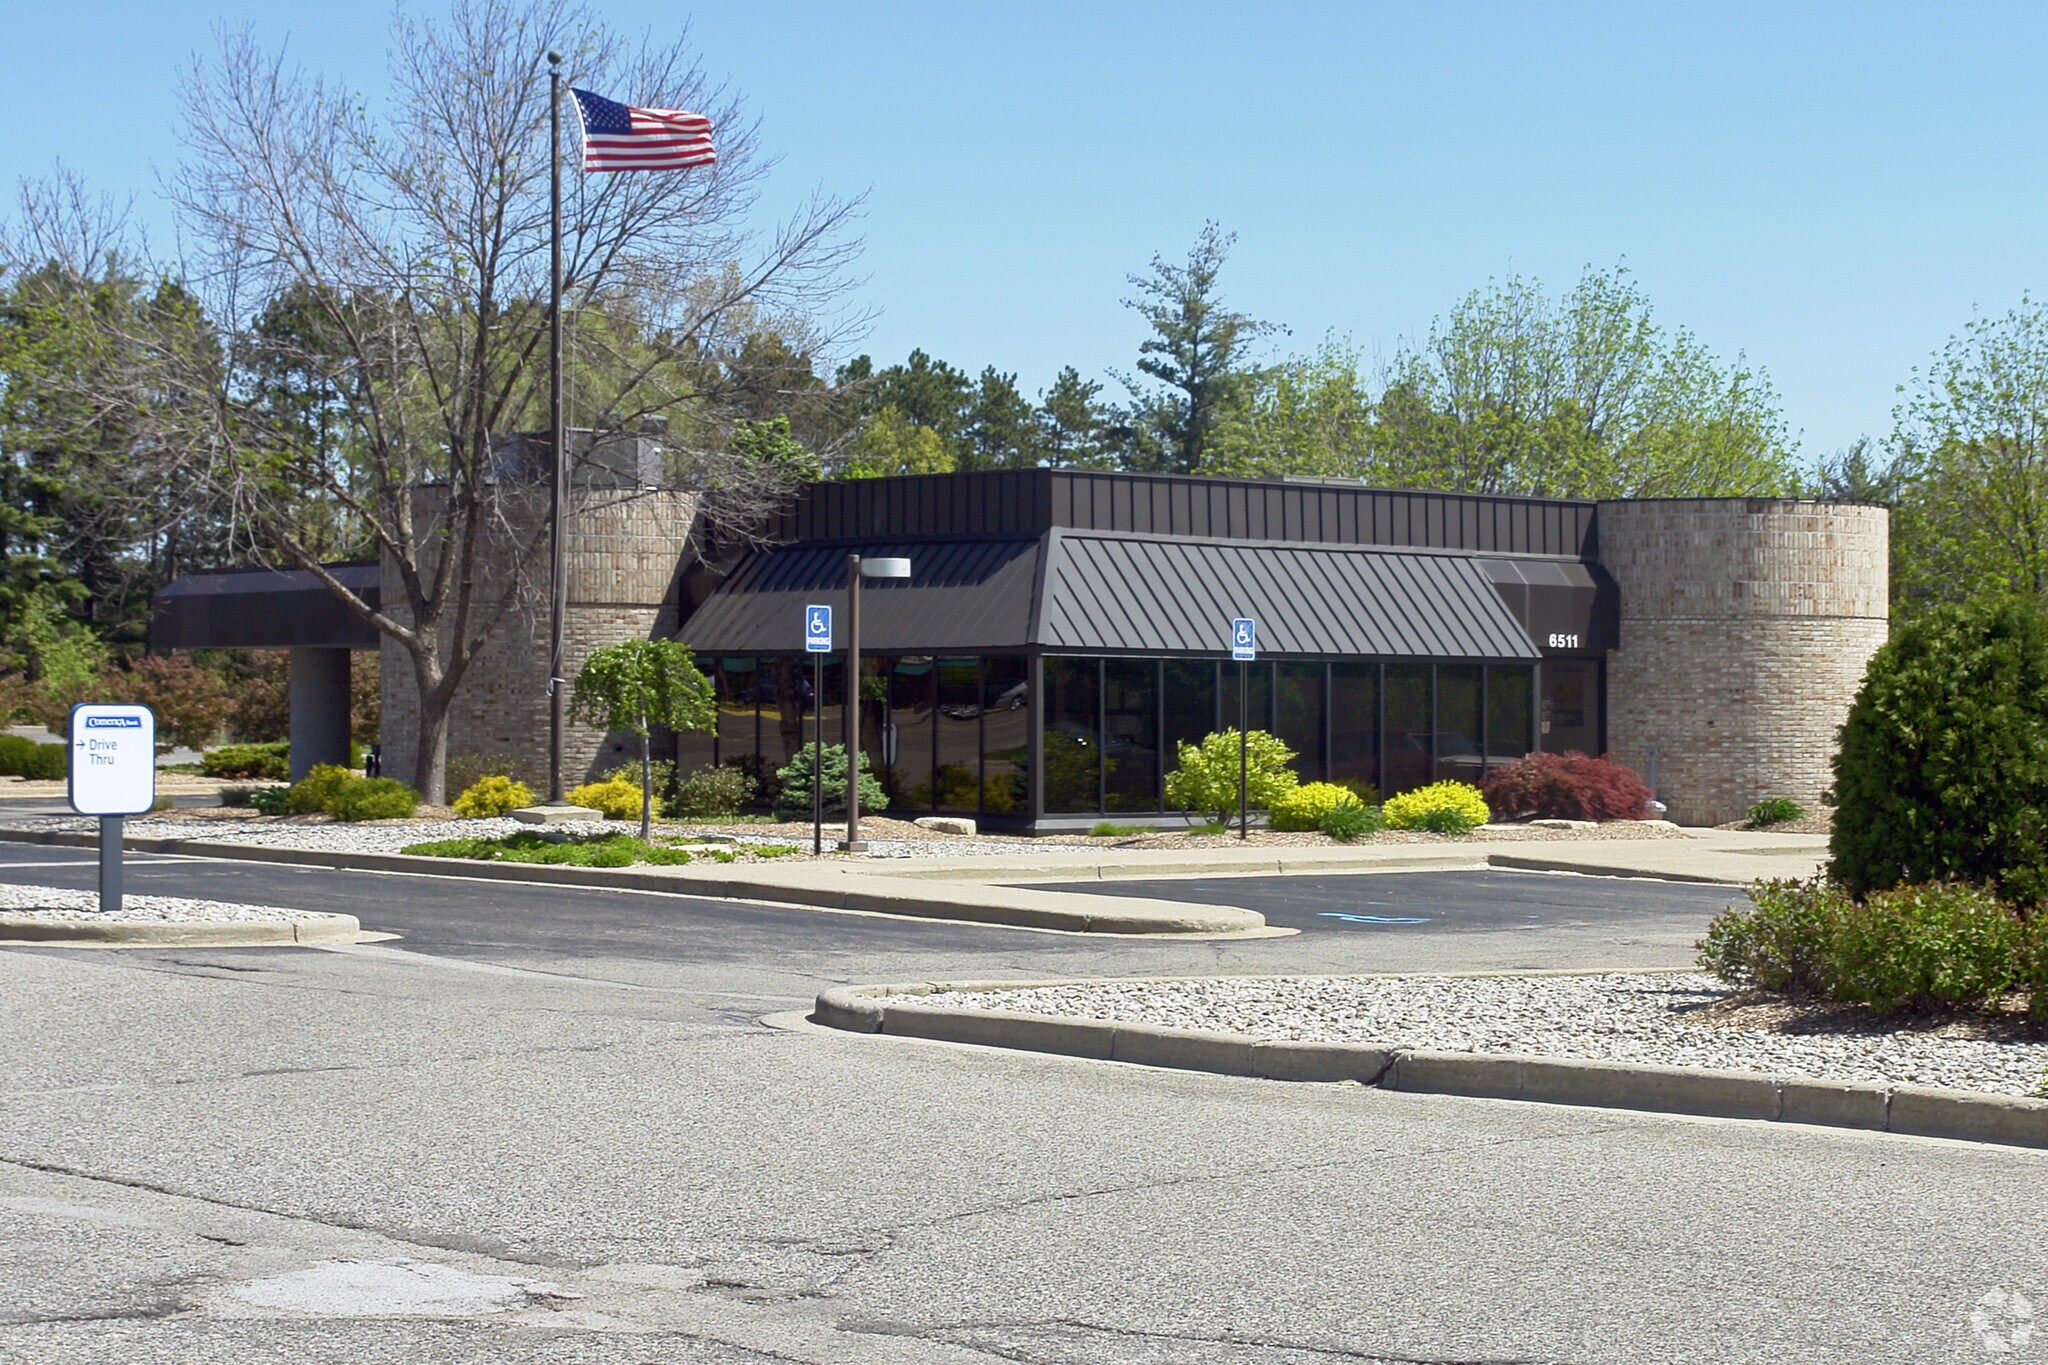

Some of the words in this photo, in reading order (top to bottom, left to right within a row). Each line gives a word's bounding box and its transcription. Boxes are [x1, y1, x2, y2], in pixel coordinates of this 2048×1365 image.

[1549, 633, 1578, 648] 6511
[89, 738, 118, 751] Drive
[89, 753, 115, 765] Thru
